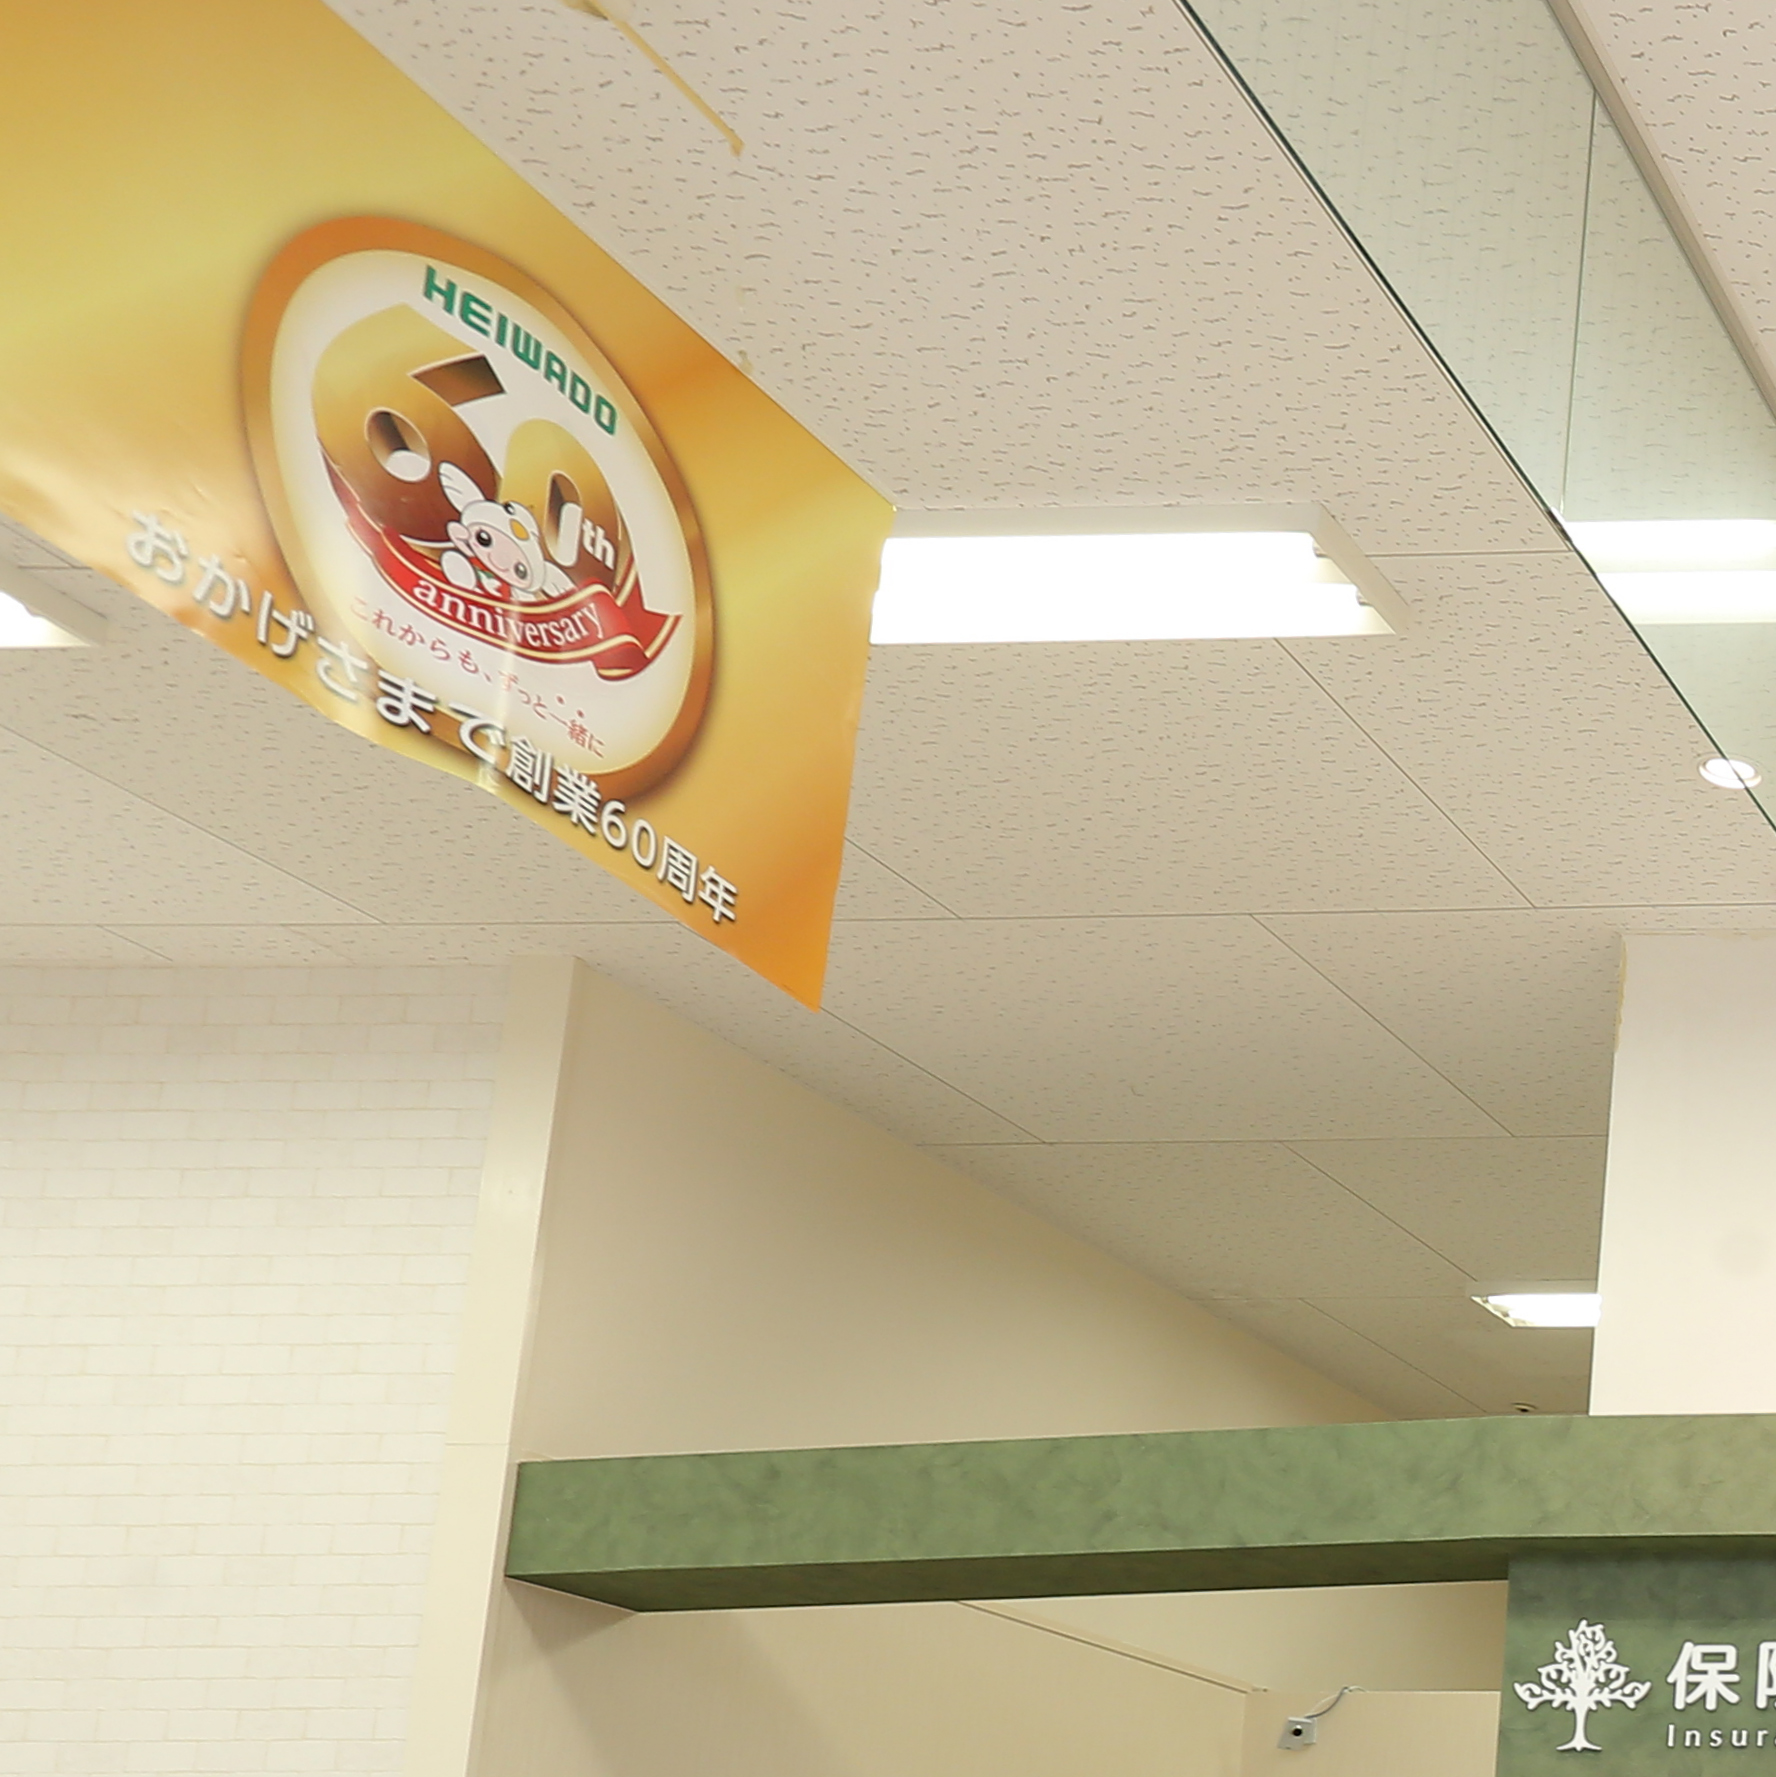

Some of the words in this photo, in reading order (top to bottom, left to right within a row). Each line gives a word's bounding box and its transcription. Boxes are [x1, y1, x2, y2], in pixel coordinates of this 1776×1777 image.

[423, 264, 619, 437] HEIWADO
[412, 577, 604, 651] anniversary
[126, 507, 738, 925] おかげさまで創業60周年
